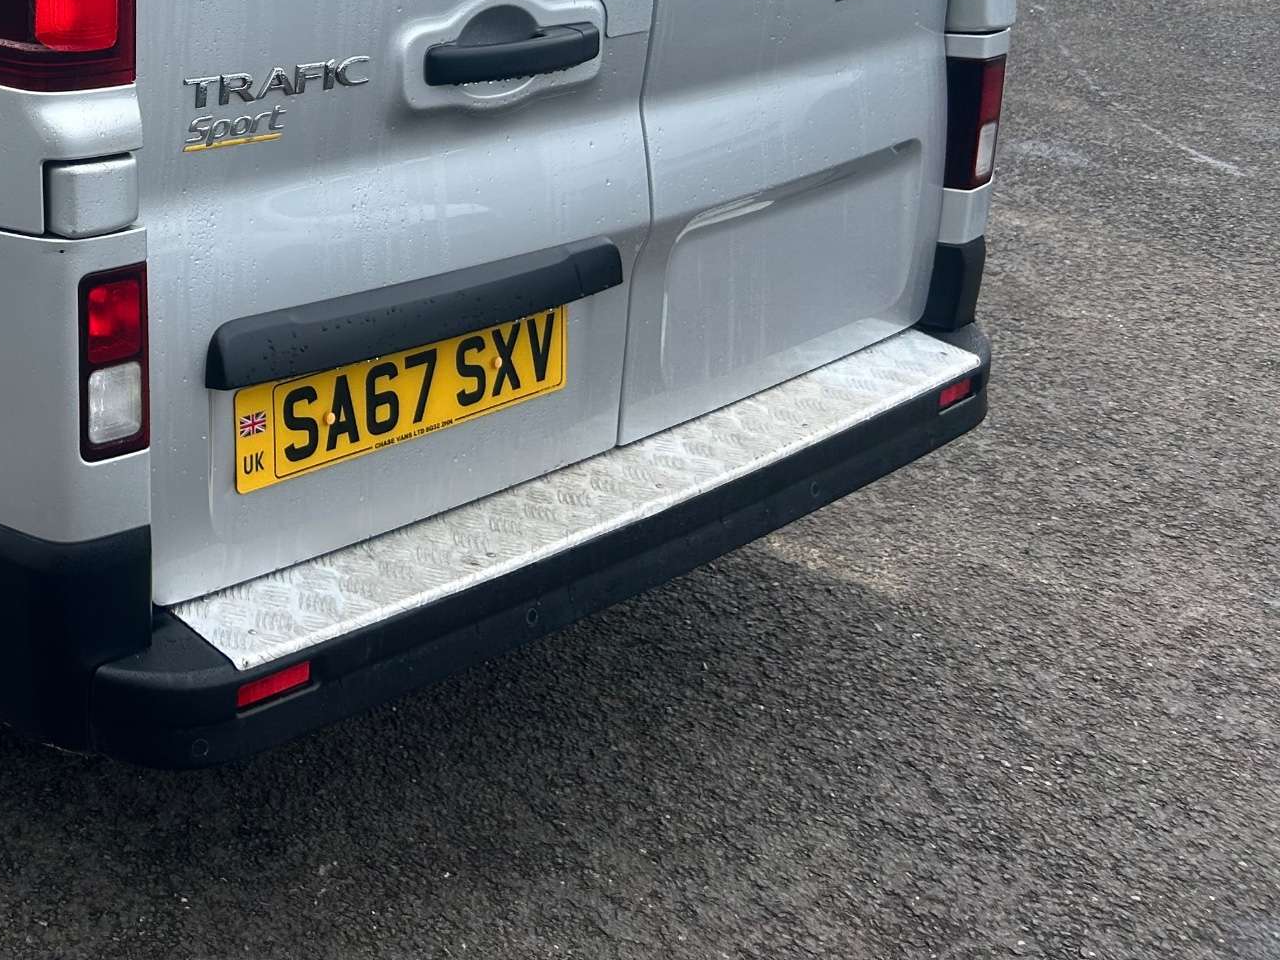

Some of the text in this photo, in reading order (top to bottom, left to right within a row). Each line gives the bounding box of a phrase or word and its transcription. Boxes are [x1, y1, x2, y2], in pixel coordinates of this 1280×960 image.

[183, 55, 370, 109] TRAFIC
[184, 104, 287, 146] Sport
[283, 313, 554, 462] SA67 SXV
[396, 431, 413, 443] VANS
[413, 428, 425, 437] LTD
[243, 450, 264, 475] UK
